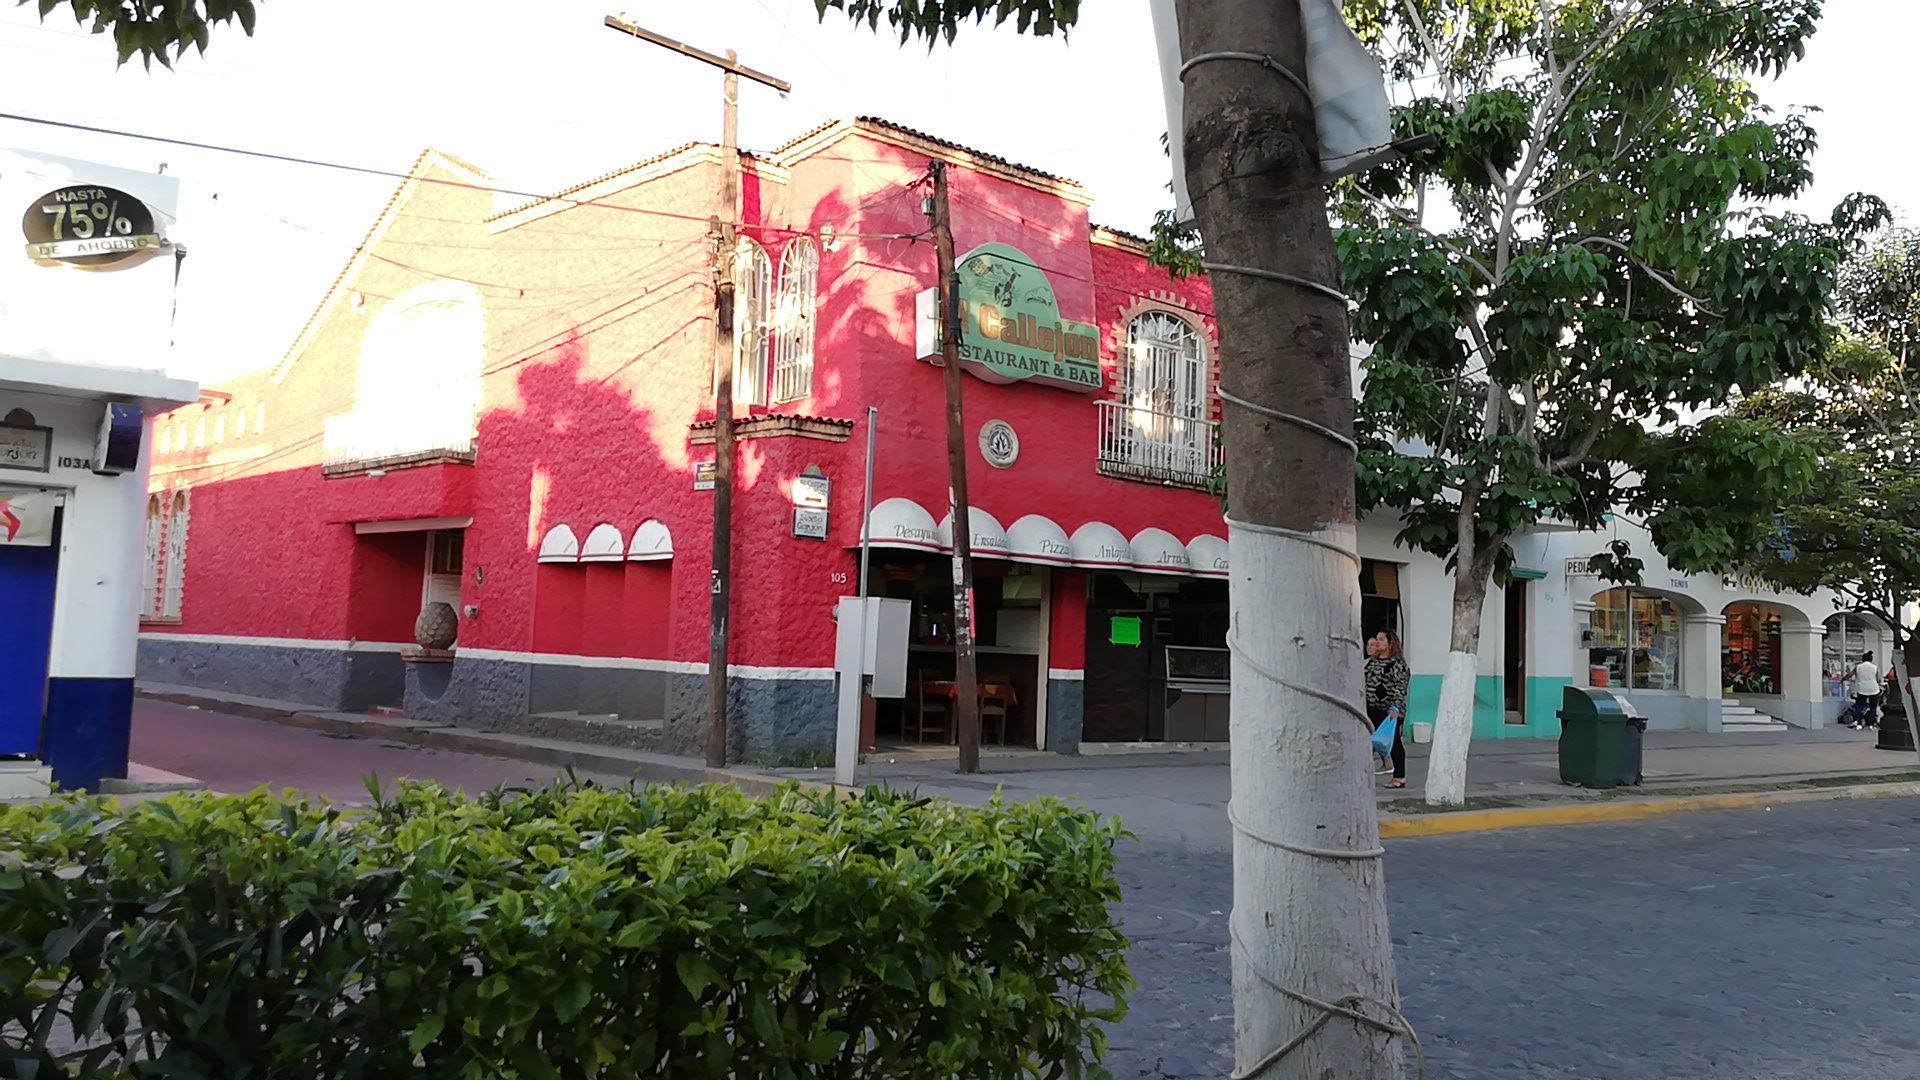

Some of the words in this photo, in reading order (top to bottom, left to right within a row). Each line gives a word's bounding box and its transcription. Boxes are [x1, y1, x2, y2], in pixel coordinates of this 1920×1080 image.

[55, 188, 107, 202] HASTA
[42, 200, 132, 240] 75%
[38, 245, 61, 256] DE
[77, 238, 148, 252] AHORRO
[979, 302, 1098, 362] Callejón
[1053, 363, 1065, 378] &
[1069, 367, 1101, 386] BAR
[57, 455, 91, 470] 103A
[1567, 561, 1592, 574] PEDIA
[831, 572, 847, 584] 105
[1669, 578, 1689, 589] TENIS
